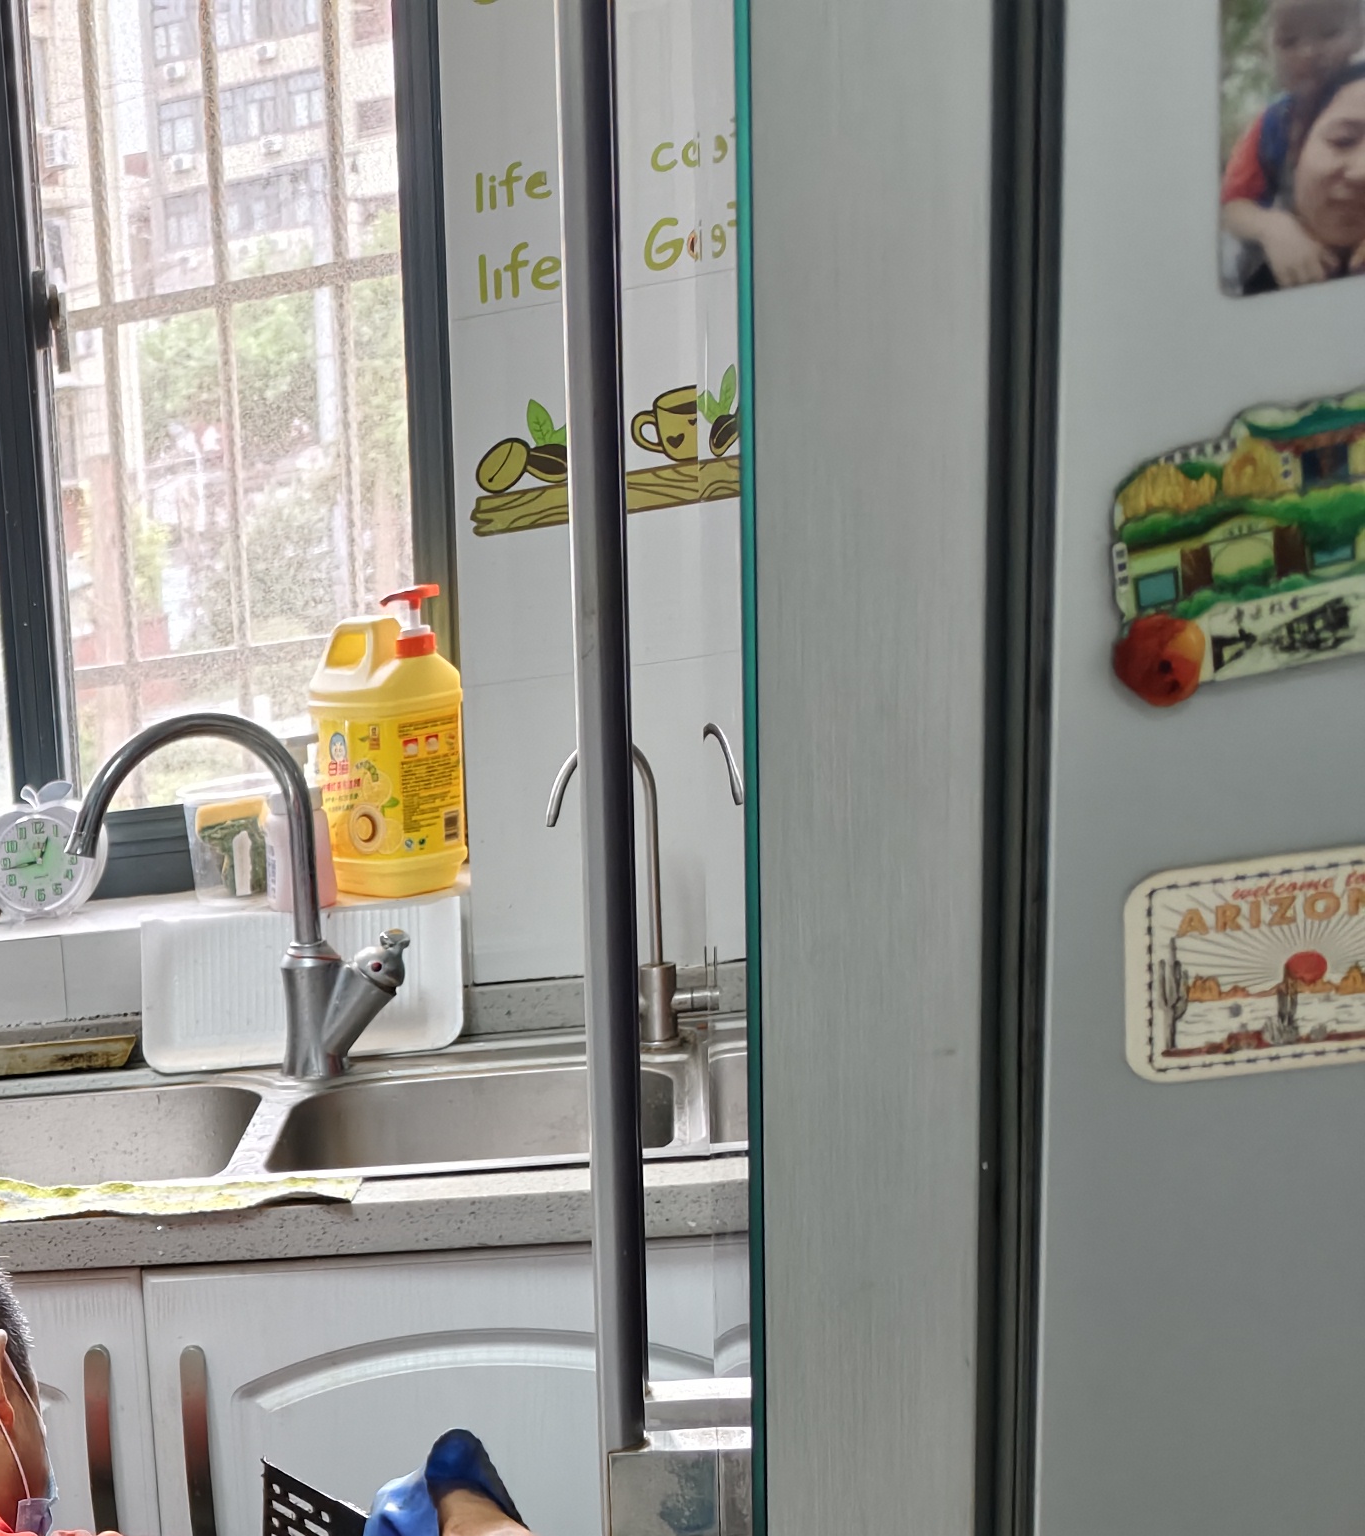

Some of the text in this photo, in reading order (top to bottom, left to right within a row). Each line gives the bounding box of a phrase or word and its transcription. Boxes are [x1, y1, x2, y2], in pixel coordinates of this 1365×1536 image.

[476, 161, 552, 213] life
[479, 242, 562, 304] life
[32, 821, 45, 834] 12
[5, 840, 18, 853] 10
[1, 857, 11, 870] 9
[6, 874, 17, 886] 8
[64, 869, 74, 881] 4
[18, 886, 28, 898] 7
[35, 889, 46, 902] 6
[52, 883, 63, 895] 5
[1232, 878, 1334, 900] welcome
